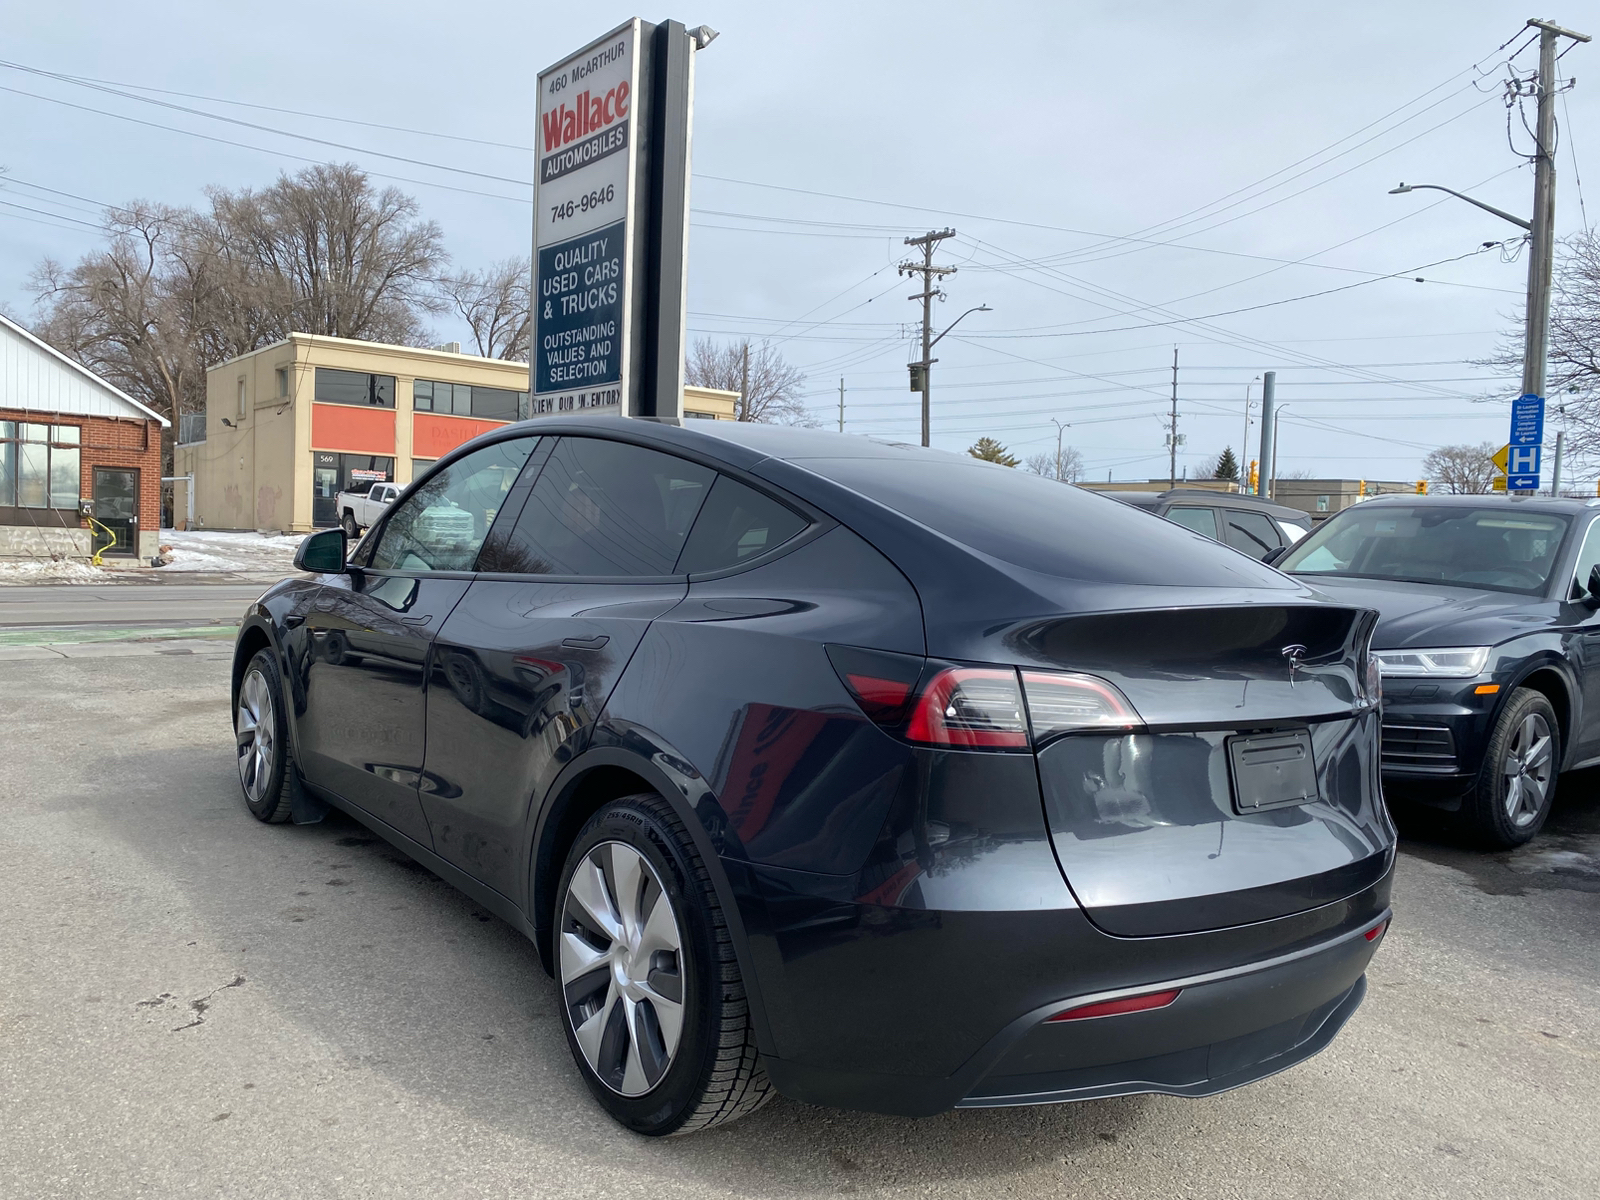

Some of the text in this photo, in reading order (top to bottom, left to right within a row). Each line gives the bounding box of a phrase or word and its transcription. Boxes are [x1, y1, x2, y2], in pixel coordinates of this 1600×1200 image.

[549, 41, 625, 94] 460 McARTHUR
[542, 80, 630, 153] Wallace
[546, 126, 624, 178] AUTOMOBILES
[551, 184, 614, 223] 746-9646
[554, 238, 609, 271] QUALITY
[543, 257, 619, 296] USED CARS
[543, 282, 617, 320] & TRUCKS
[544, 320, 615, 350] OUTSTANDING
[547, 340, 611, 366] VALUES AND
[550, 359, 607, 383] SELECTION
[320, 454, 333, 463] 569
[1512, 447, 1537, 472] H
